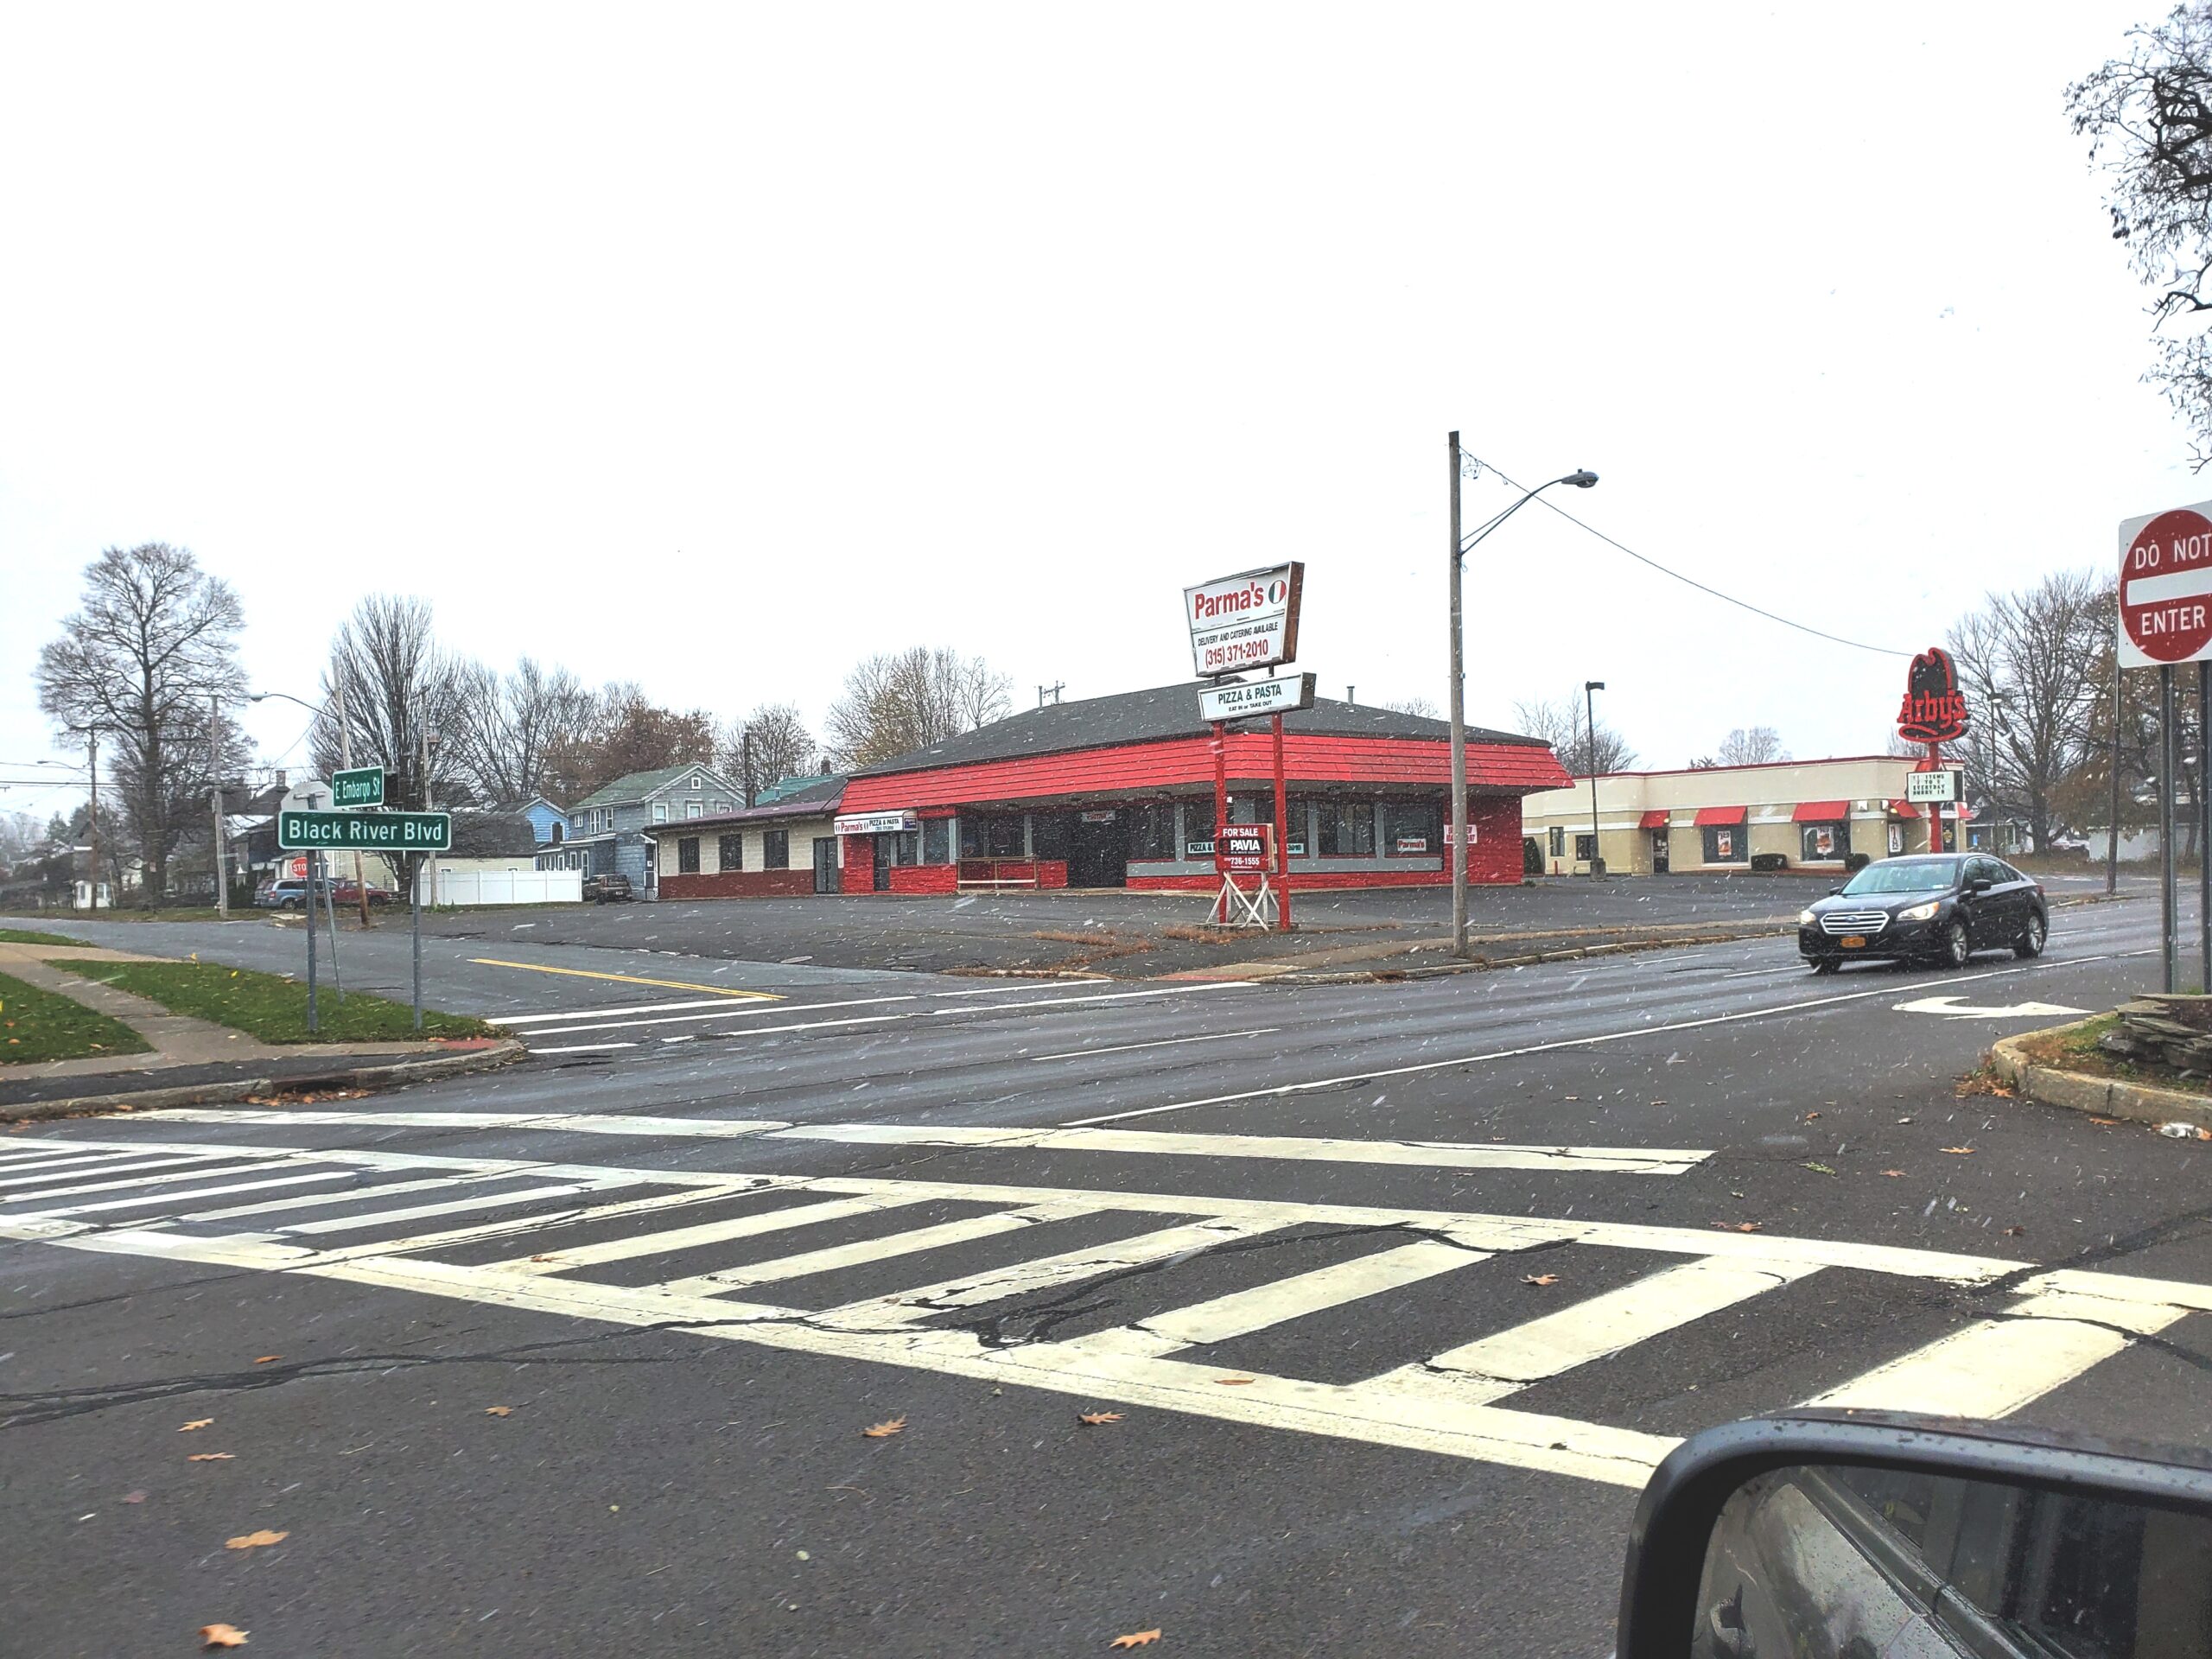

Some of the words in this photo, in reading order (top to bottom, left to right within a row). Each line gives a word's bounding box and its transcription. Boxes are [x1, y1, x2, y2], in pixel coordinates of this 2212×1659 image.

[2135, 543, 2160, 570] DO
[2174, 533, 2212, 563] NOT
[1194, 582, 1264, 620] Parma's
[2141, 605, 2206, 636] ENTER
[1198, 635, 1219, 646] DELIVERY
[1219, 632, 1229, 641] AND
[1230, 627, 1252, 639] CATERING
[1253, 622, 1278, 634] AVAILABLE
[1205, 645, 1225, 669] (315)
[1227, 639, 1268, 662] 371-2010
[1218, 690, 1243, 704] PIZZA
[1246, 689, 1252, 701] &
[1255, 684, 1282, 699] PASTA
[1897, 690, 1967, 728] Arby's
[335, 783, 340, 799] E
[342, 780, 371, 802] Embargo
[372, 777, 380, 796] St
[289, 819, 342, 840] Black
[350, 820, 397, 840] River
[404, 822, 442, 841] Blvd
[841, 822, 863, 832] Parma's
[1223, 828, 1238, 837] FOR
[1239, 828, 1258, 836] SALE
[1230, 840, 1261, 851] PAVIA
[1398, 840, 1425, 849] Parma's
[293, 863, 307, 872] STO
[1230, 857, 1260, 866] 736-1555
